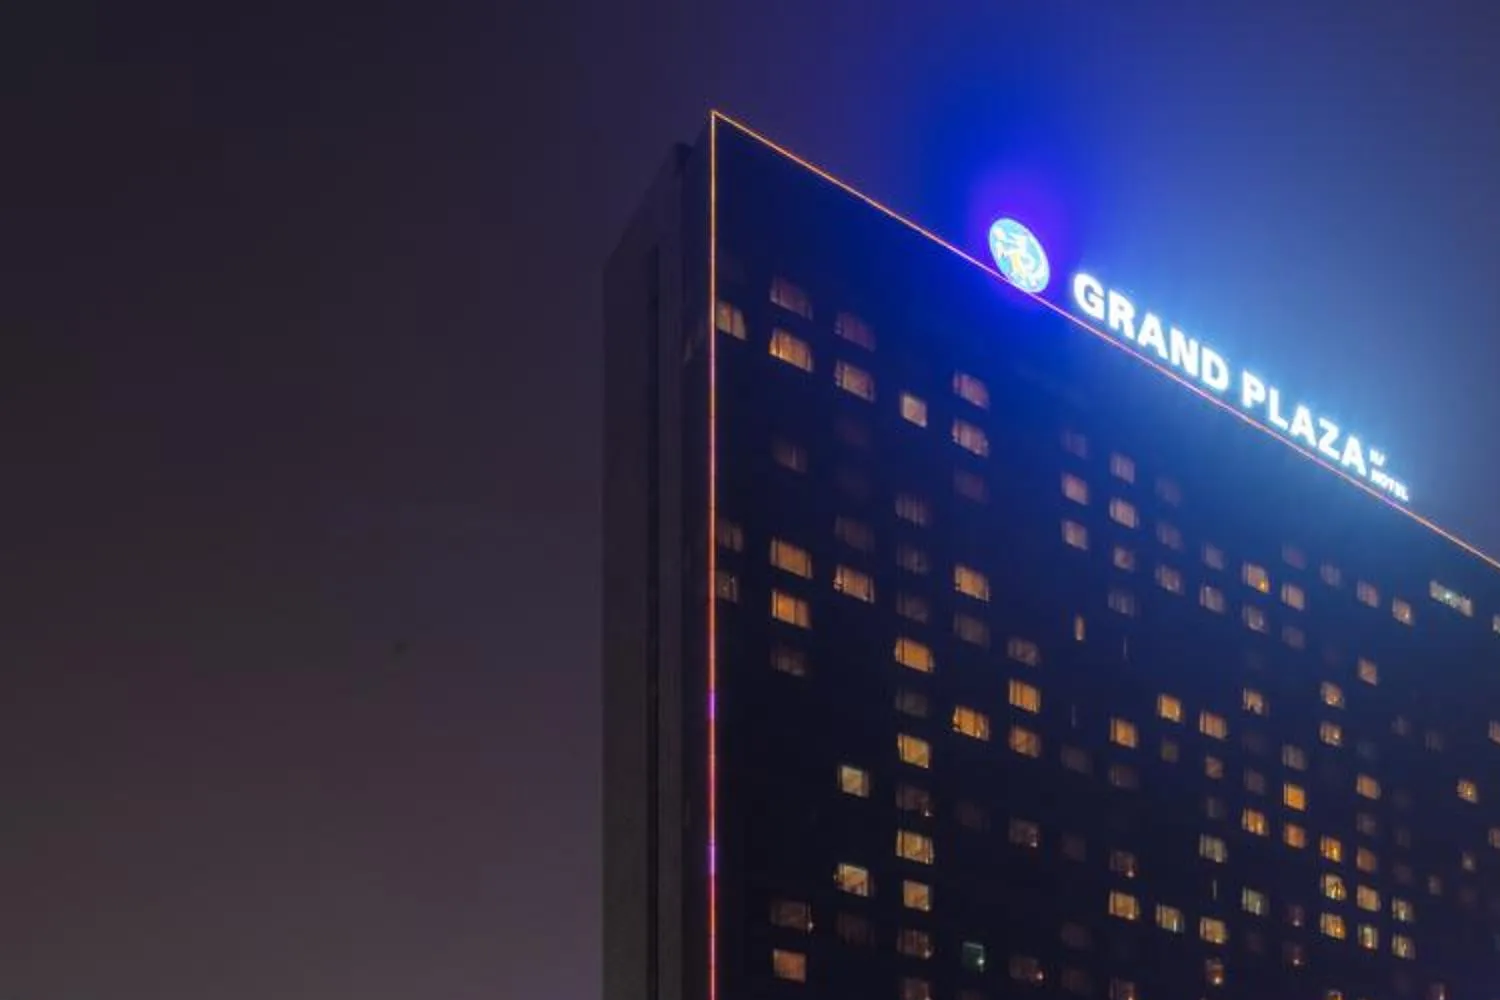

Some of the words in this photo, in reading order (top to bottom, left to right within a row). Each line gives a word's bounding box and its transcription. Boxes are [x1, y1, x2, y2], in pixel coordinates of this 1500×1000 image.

[1073, 272, 1230, 391] GRAND
[1242, 370, 1367, 475] PLAZA
[1371, 468, 1409, 501] HOTEL
